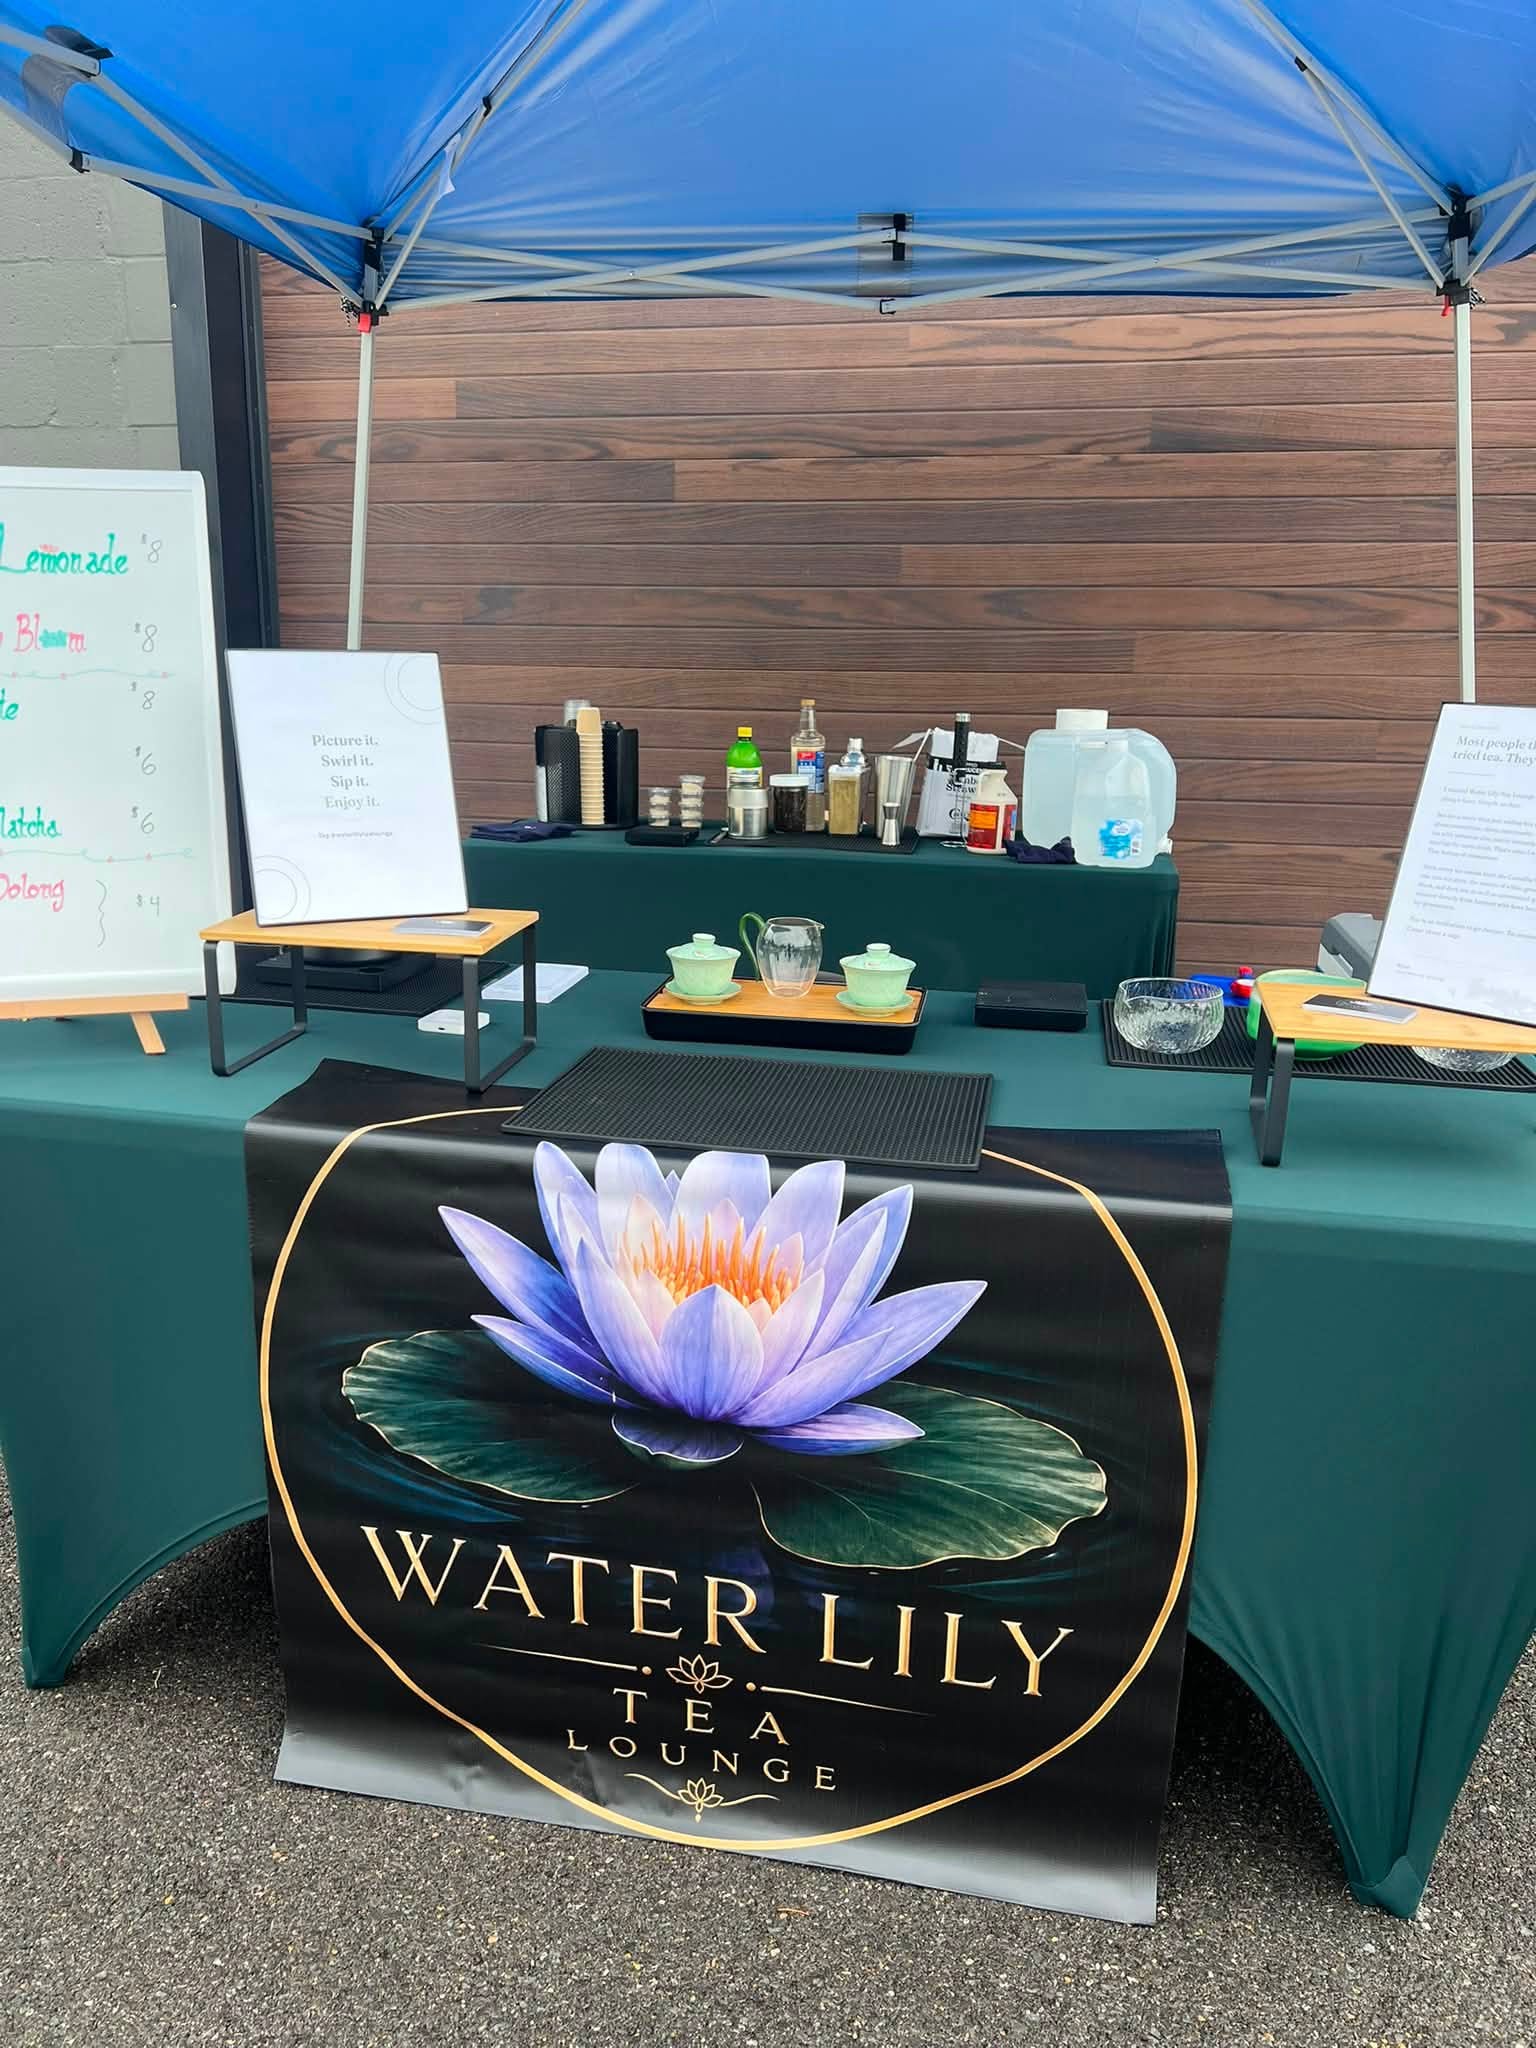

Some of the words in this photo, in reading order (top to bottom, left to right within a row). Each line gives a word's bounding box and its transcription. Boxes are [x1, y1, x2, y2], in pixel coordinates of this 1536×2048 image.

[0, 522, 129, 575] Lemonade
[13, 612, 87, 653] Blm
[312, 734, 362, 746] Picture
[365, 734, 379, 746] it.
[1456, 735, 1485, 747] Most
[1486, 738, 1526, 751] people
[320, 753, 358, 767] Swirl
[360, 754, 375, 767] it.
[1453, 751, 1481, 761] tried
[330, 775, 353, 790] Sip
[355, 775, 369, 787] it.
[325, 796, 363, 810] Enjoy
[366, 795, 381, 808] it.
[361, 1525, 767, 1654] WATER
[819, 1592, 1076, 1697] LILY
[612, 1687, 791, 1746] TEA
[566, 1728, 837, 1792] LOUNGE
